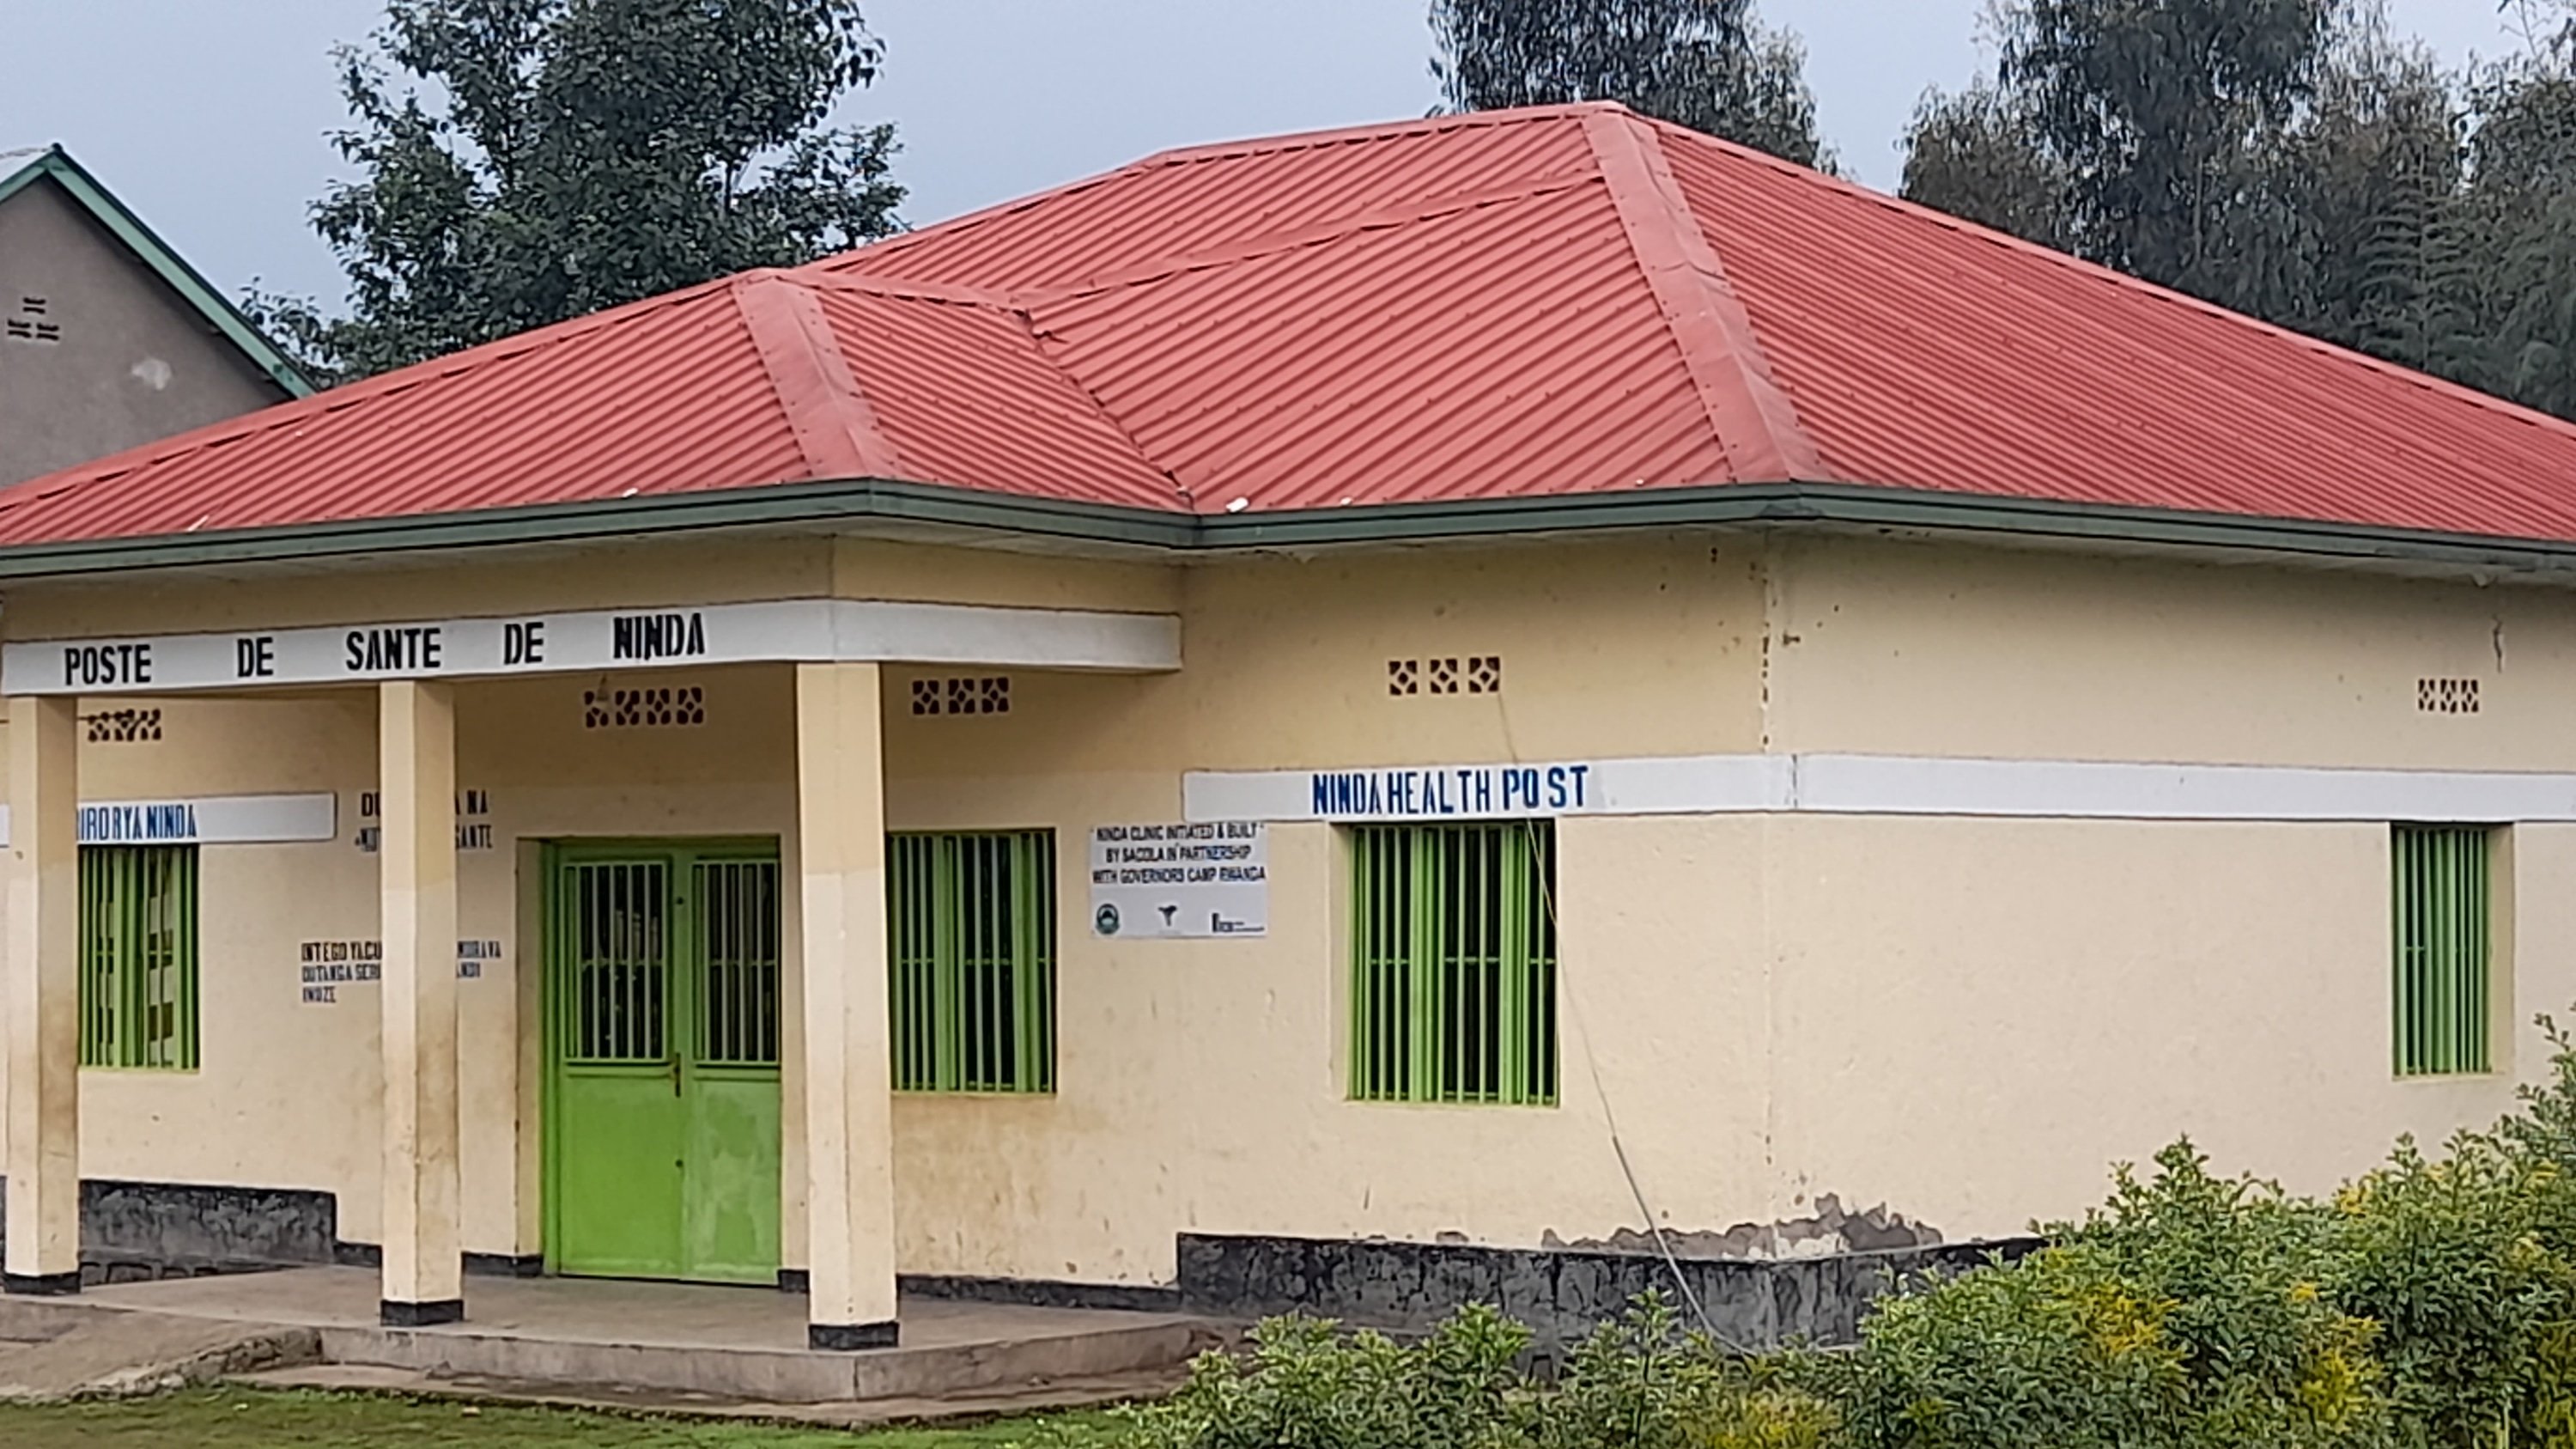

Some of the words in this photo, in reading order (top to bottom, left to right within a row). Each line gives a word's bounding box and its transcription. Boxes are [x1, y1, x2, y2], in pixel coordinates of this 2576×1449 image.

[64, 644, 151, 685] POSTE
[237, 636, 274, 678] DE
[345, 627, 441, 671] SANTE
[503, 621, 544, 666] DE
[613, 612, 706, 660] NINDA
[1312, 772, 1382, 815] NINDA
[1387, 770, 1491, 814] HEALTH
[1502, 765, 1589, 811] POST
[146, 803, 197, 839] NINDA
[1130, 825, 1163, 841] CLINIC
[1166, 824, 1214, 841] INITIATED
[1227, 821, 1258, 839] BUILT
[1106, 847, 1120, 863] BY
[1180, 844, 1252, 861] PARTNERSHIP
[1188, 867, 1217, 883] CAMP
